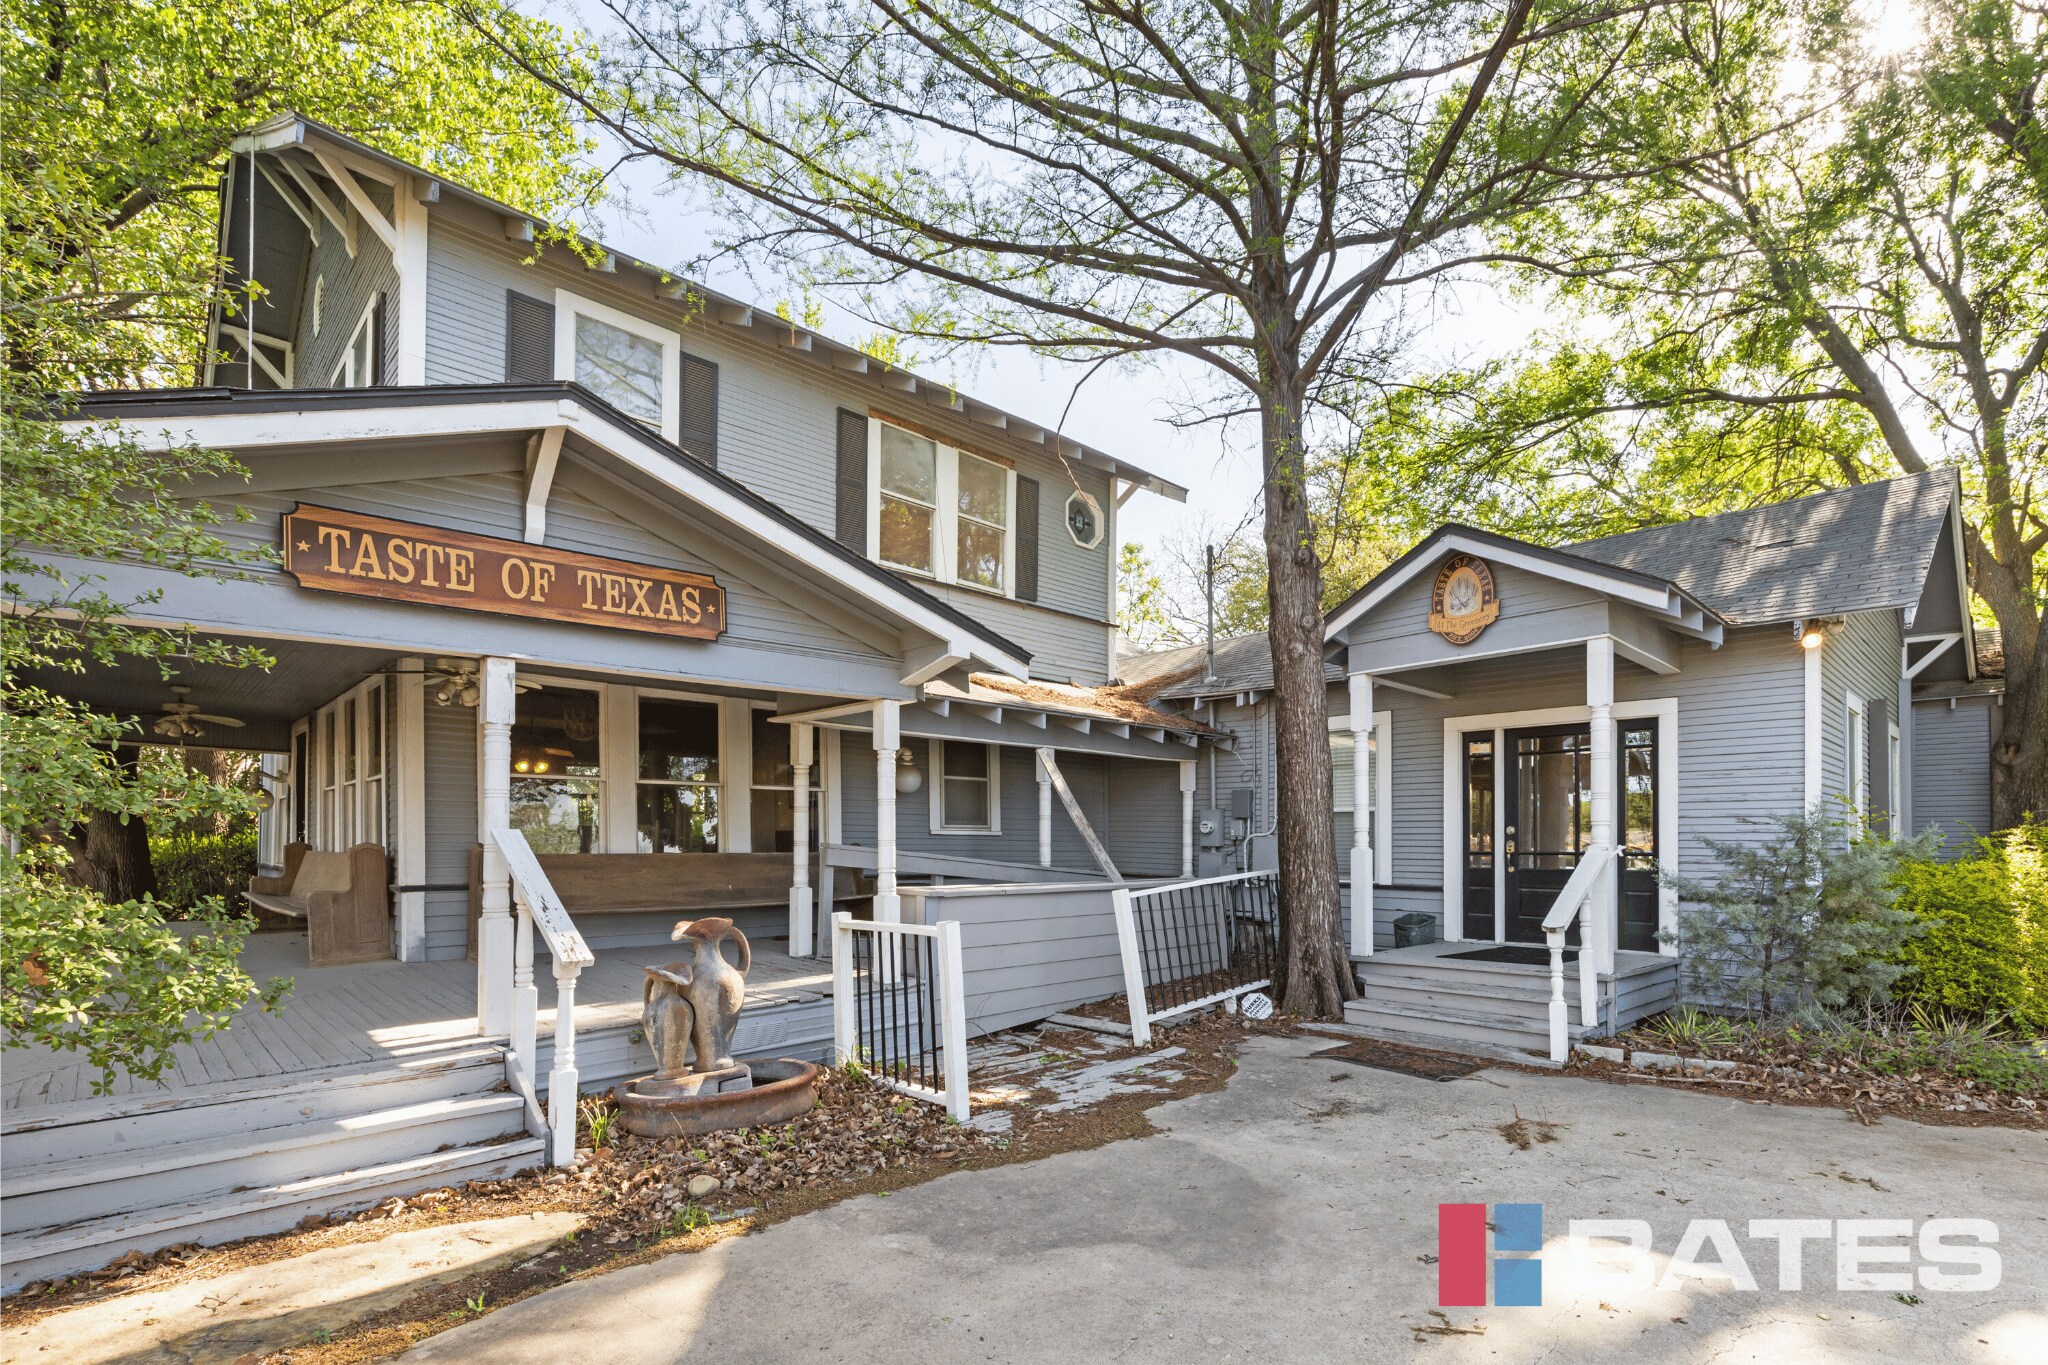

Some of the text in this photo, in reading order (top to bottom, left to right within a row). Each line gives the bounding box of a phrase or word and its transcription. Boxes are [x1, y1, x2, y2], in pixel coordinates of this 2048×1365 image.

[317, 525, 702, 625] TASTE OF TEXAS
[1436, 557, 1490, 601] TASTE OF TEXAS
